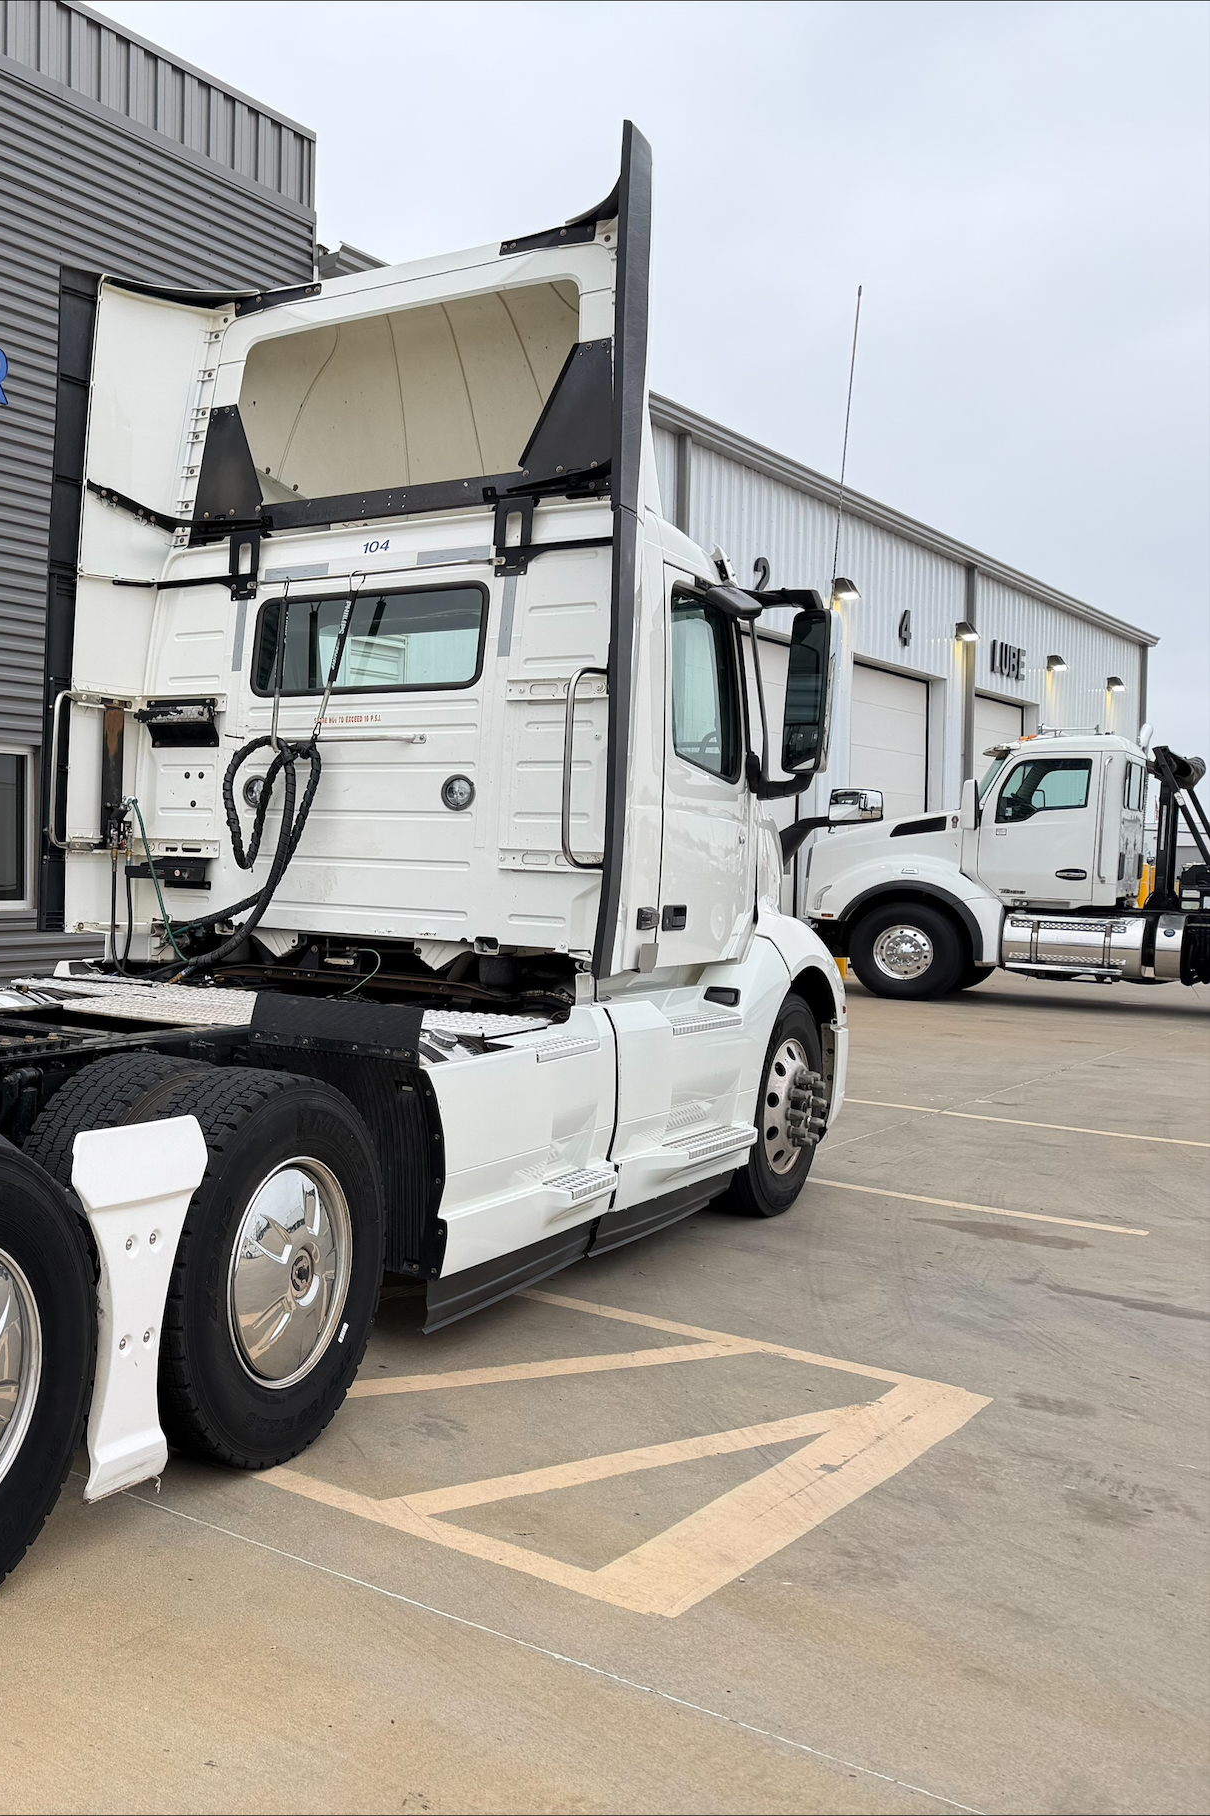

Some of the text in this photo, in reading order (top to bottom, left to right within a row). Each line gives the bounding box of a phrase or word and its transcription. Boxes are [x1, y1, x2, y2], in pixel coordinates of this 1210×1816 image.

[363, 539, 390, 554] 104
[753, 556, 770, 591] 2
[898, 609, 912, 647] 4
[990, 639, 1026, 681] LUBE
[346, 715, 362, 723] EXCEED
